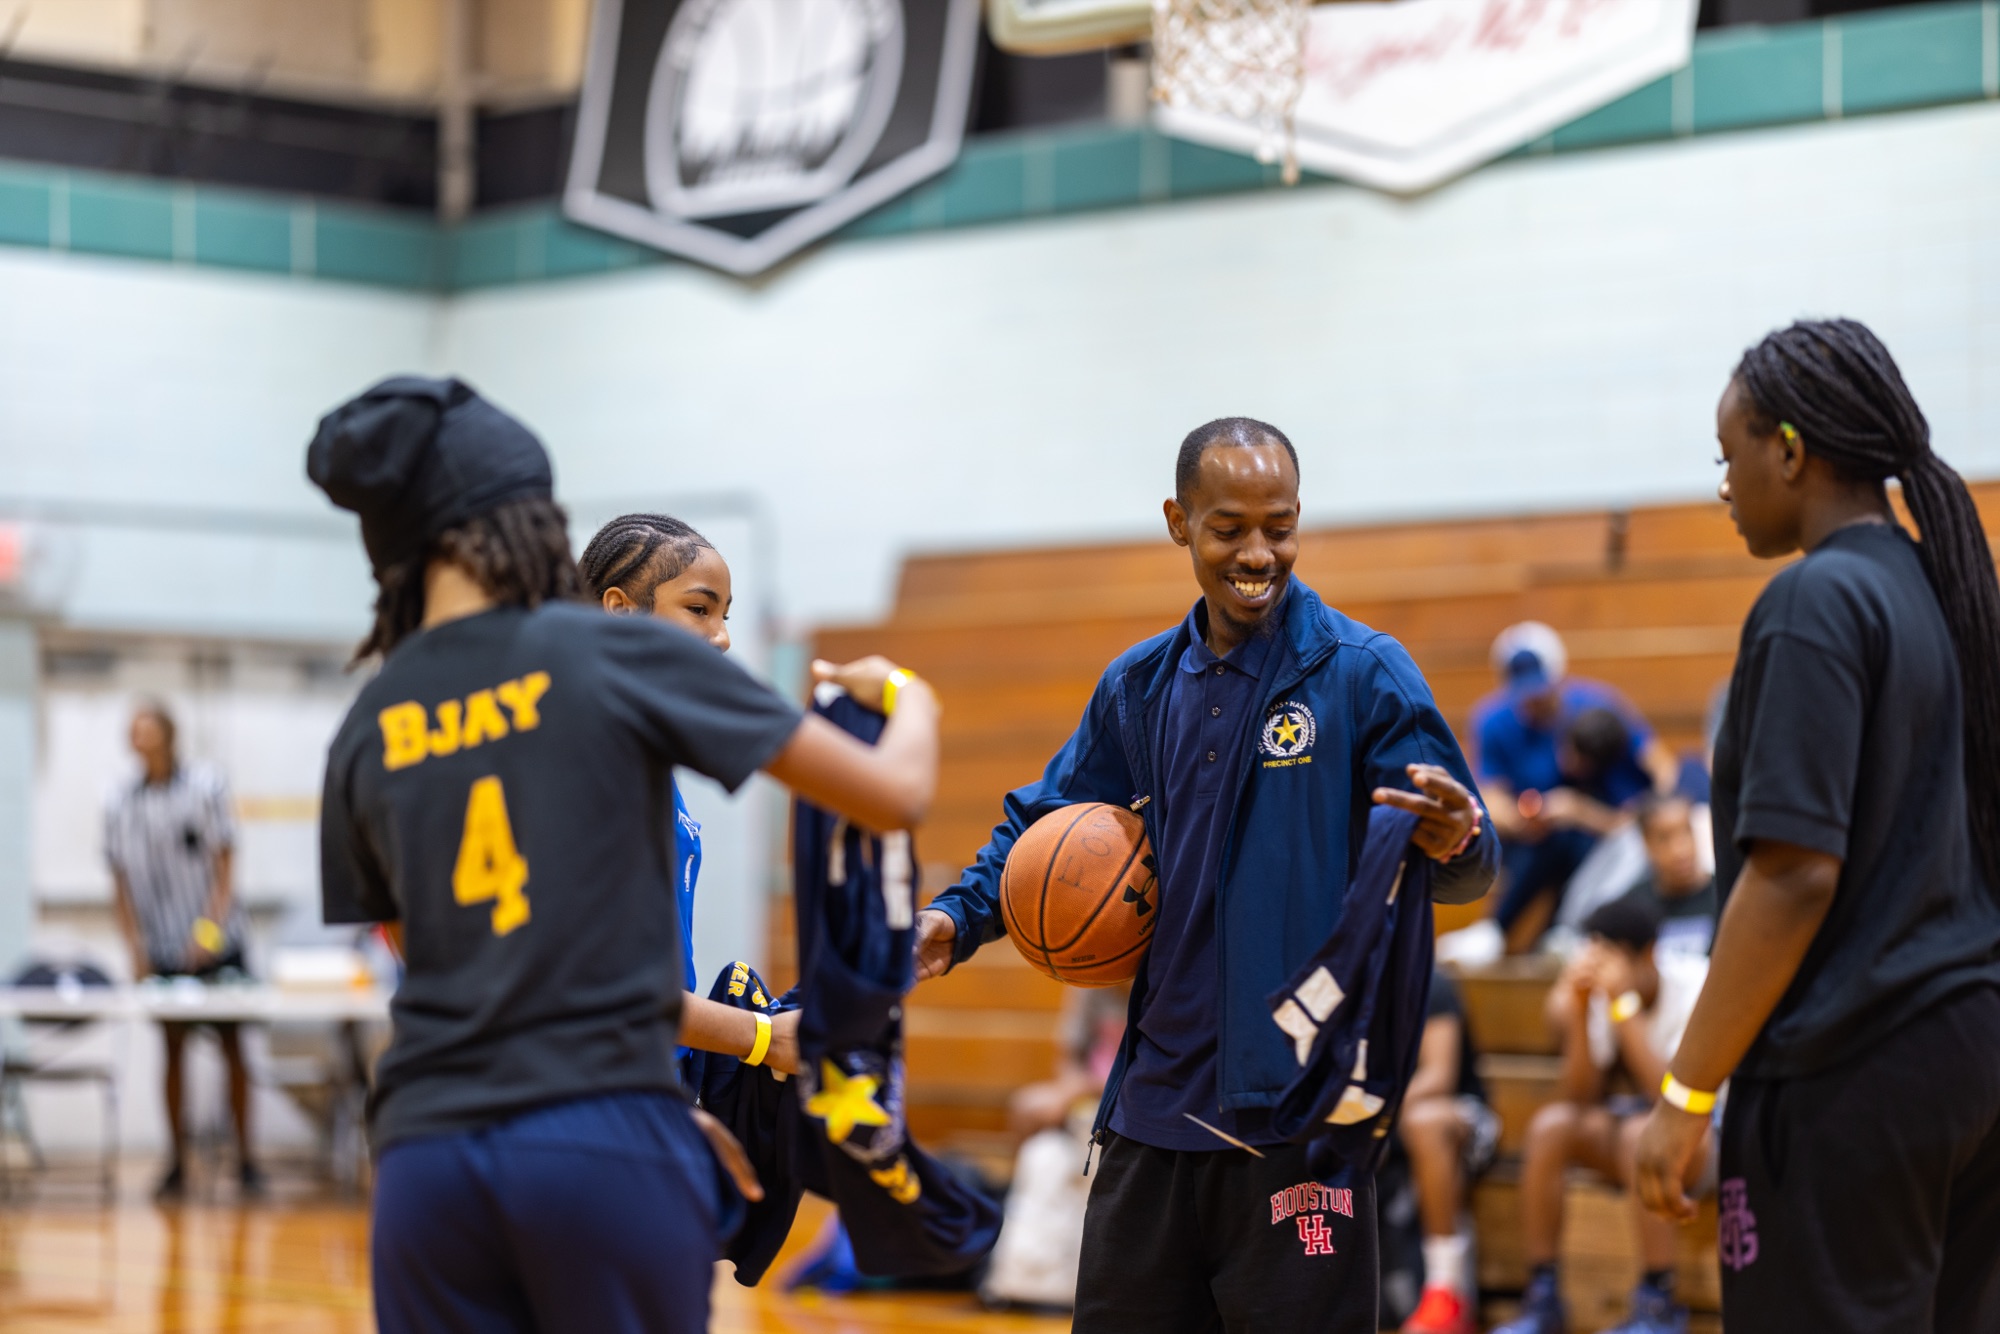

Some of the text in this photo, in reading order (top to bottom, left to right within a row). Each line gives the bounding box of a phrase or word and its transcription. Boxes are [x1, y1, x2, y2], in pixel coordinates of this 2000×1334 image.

[378, 671, 551, 772] BJAY
[1290, 700, 1312, 719] HARRIS
[1308, 717, 1317, 748] COUNTY
[1263, 756, 1312, 768] PRECINCT ONE
[453, 774, 531, 937] 4
[1270, 1182, 1354, 1225] HOUSTON
